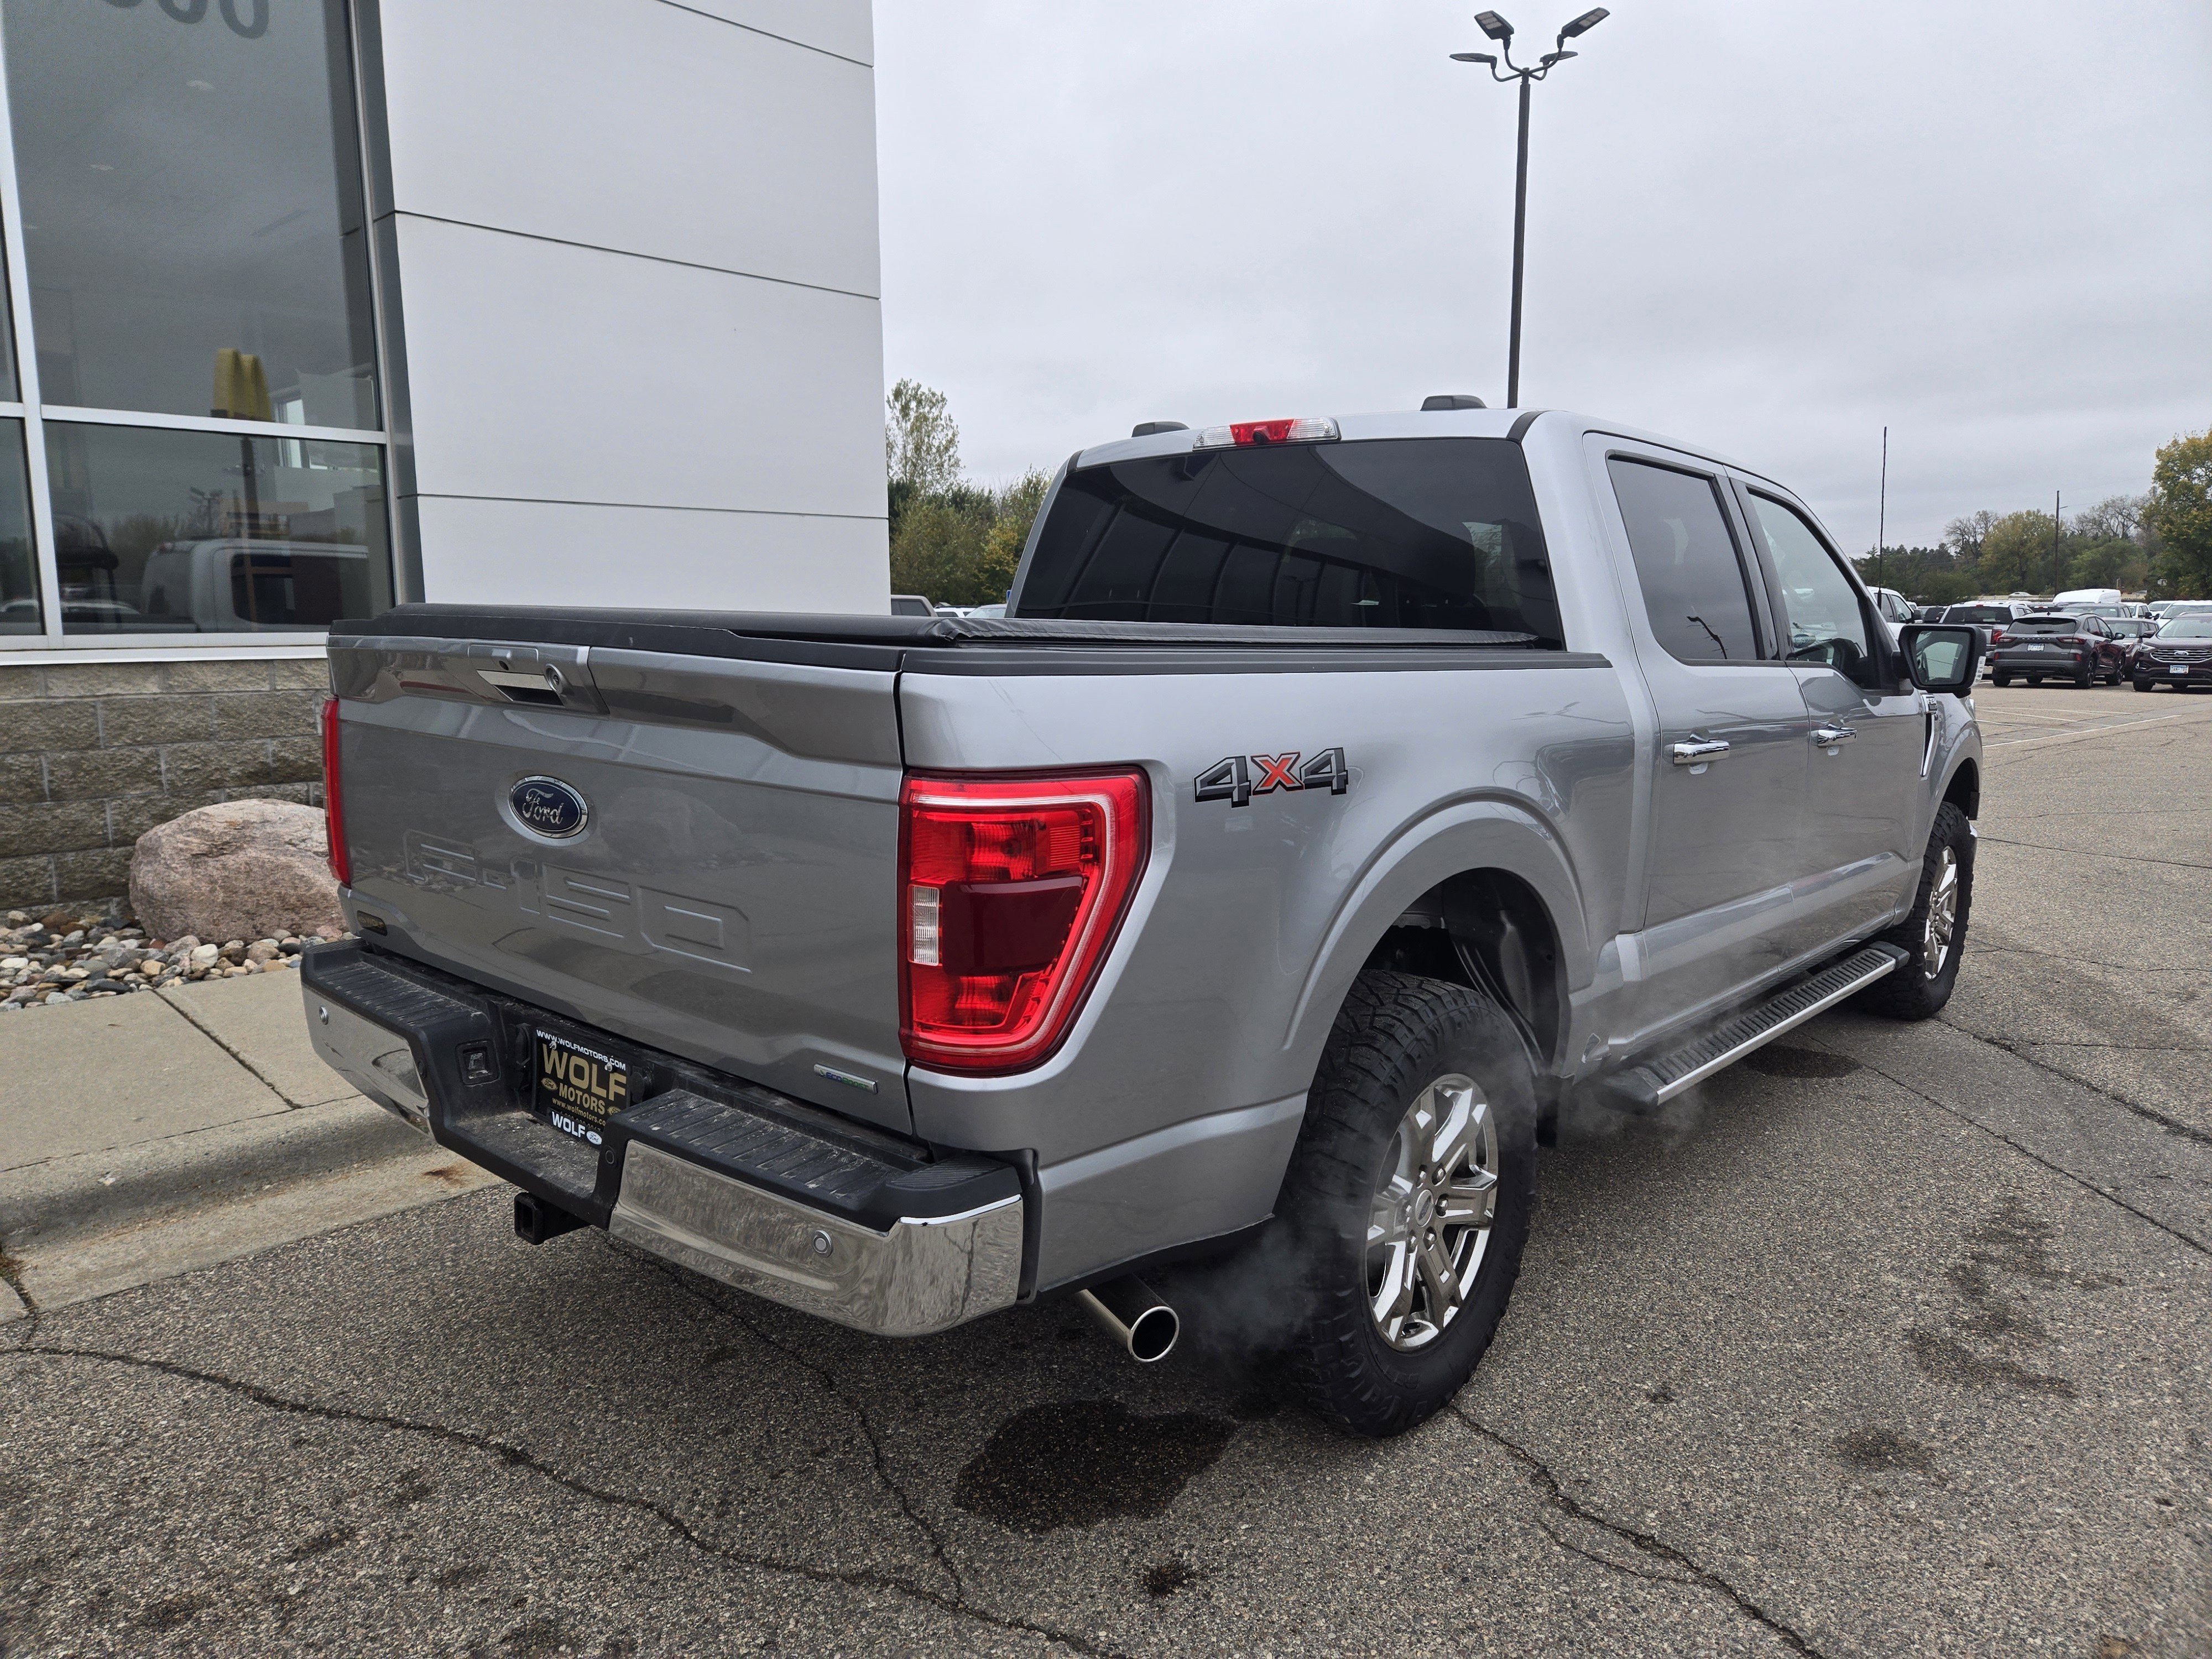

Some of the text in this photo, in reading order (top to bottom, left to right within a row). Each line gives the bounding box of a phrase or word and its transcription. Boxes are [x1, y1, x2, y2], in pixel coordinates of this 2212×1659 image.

[522, 788, 564, 825] Ford
[403, 828, 754, 974] F-150
[536, 1029, 626, 1071] WWW.WOLFMOTORS.COM
[542, 1043, 627, 1101] WOLF
[552, 1097, 606, 1126] www.wolfmotors.co
[559, 1082, 606, 1115] MOTORS
[551, 1111, 586, 1138] WOLF
